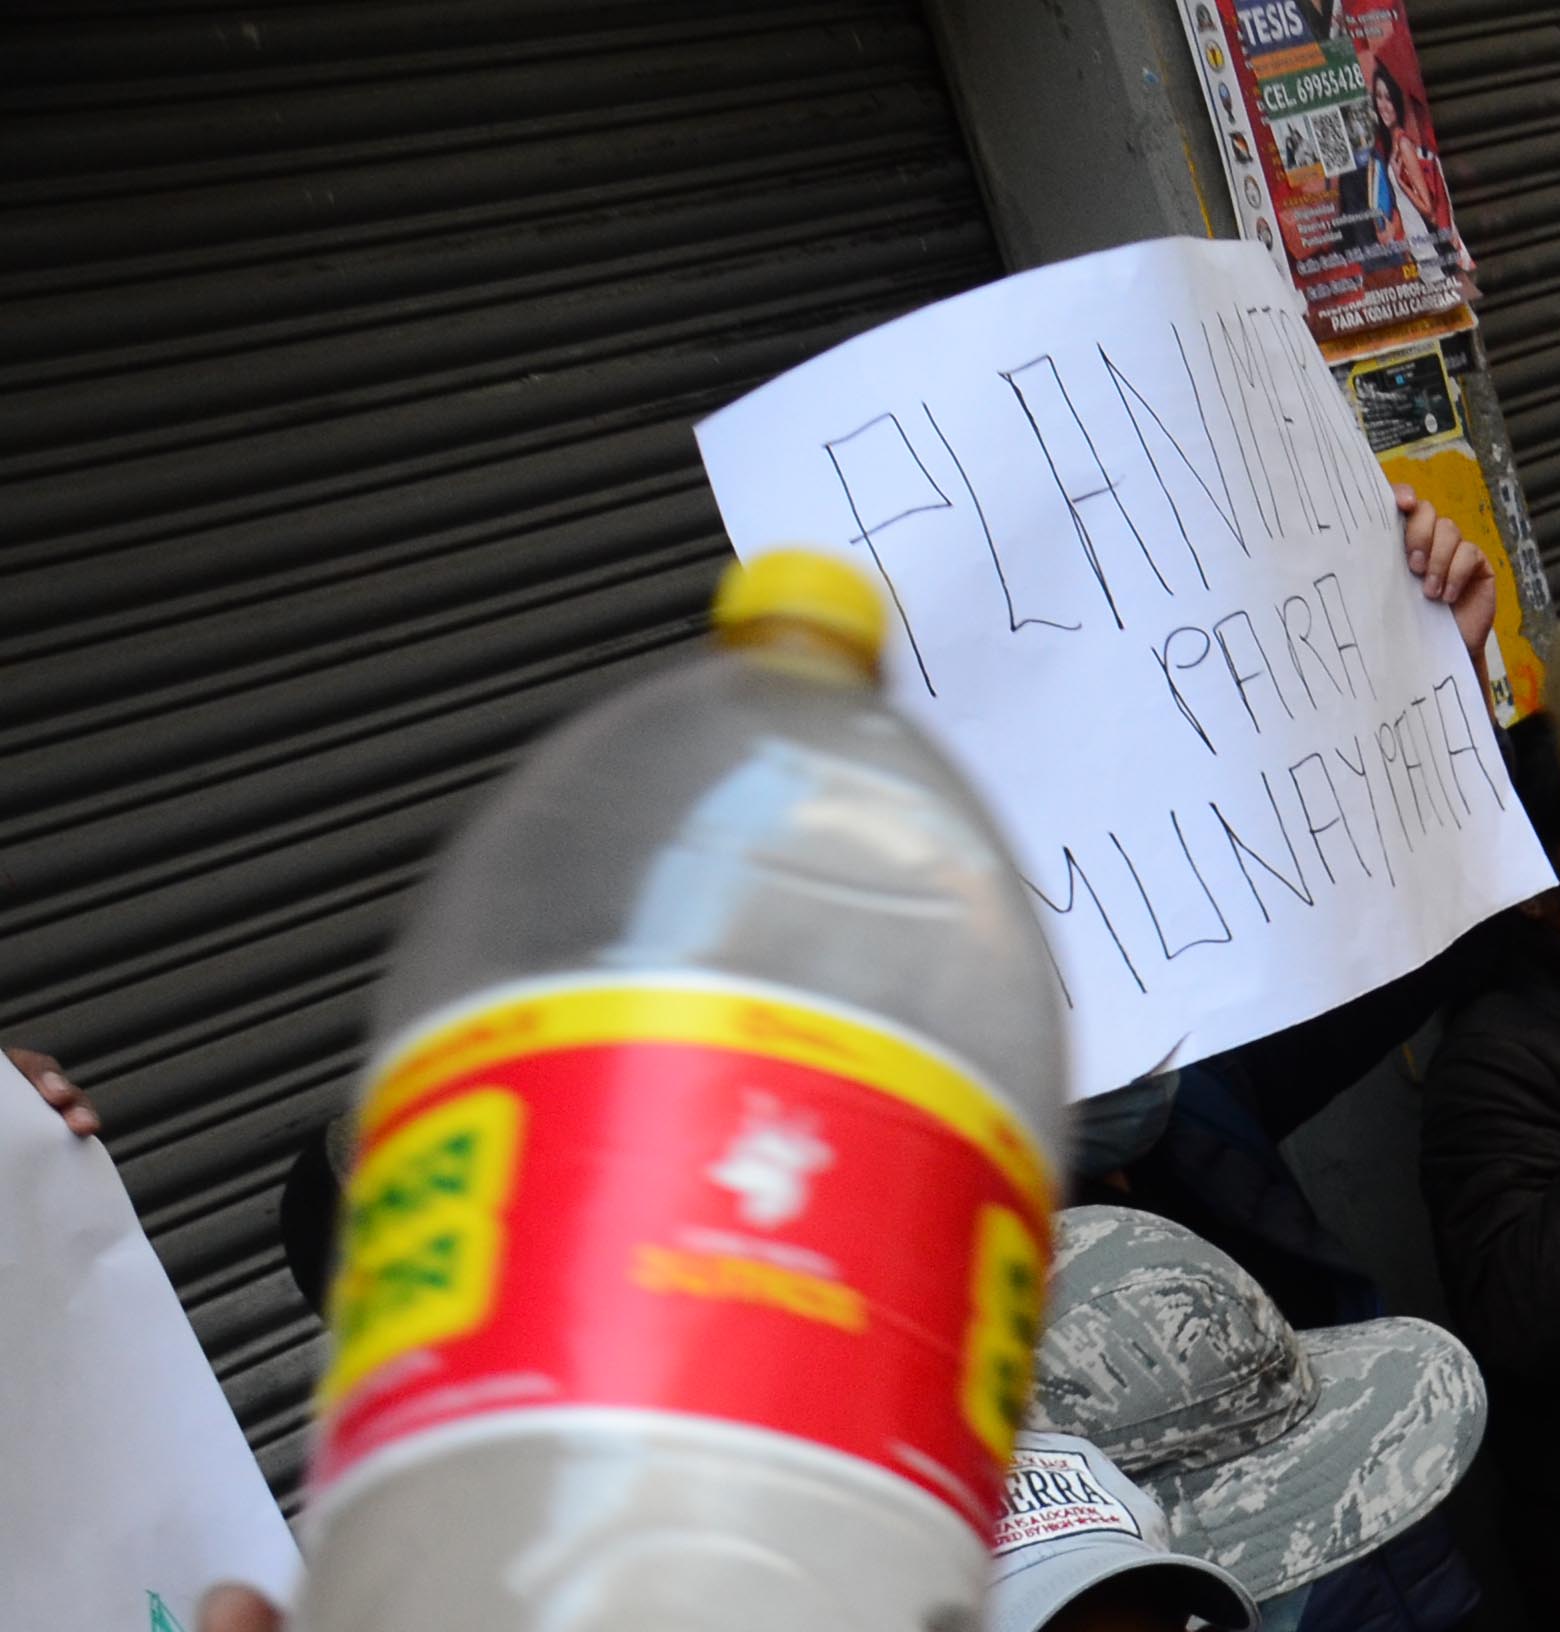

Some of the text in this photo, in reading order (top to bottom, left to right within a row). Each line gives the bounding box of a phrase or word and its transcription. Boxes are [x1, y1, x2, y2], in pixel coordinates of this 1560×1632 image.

[1238, 0, 1304, 46] TESIS
[1263, 82, 1298, 111] CEL.
[1150, 571, 1379, 757] PARA
[1003, 1468, 1114, 1515] ERRA
